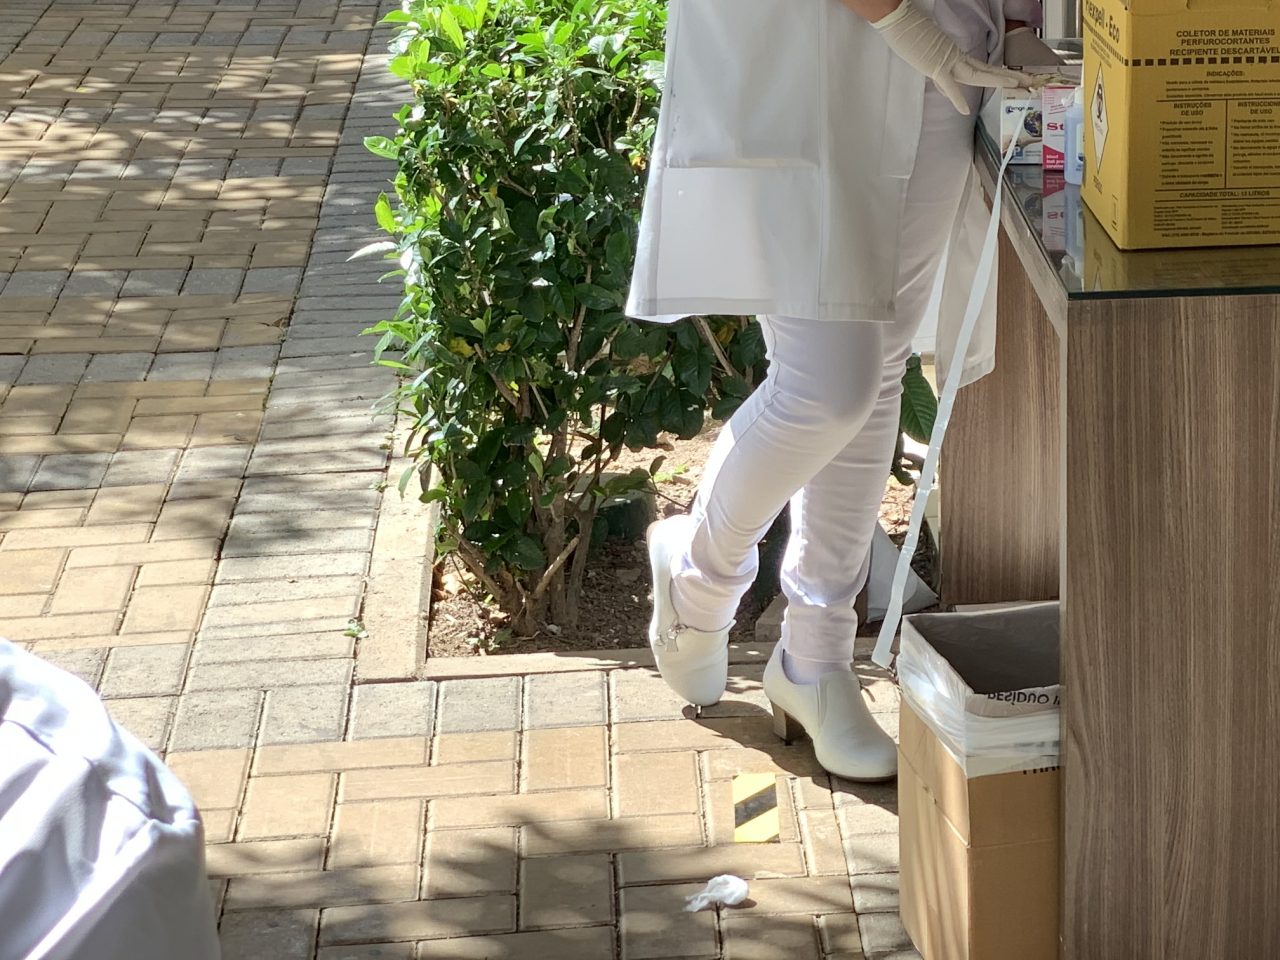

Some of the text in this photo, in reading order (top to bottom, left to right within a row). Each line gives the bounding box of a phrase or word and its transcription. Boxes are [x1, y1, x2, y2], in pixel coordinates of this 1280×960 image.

[1176, 28, 1276, 38] COLETOR DE MATERIAIS
[1181, 37, 1271, 46] PERFUROCORTANTES
[1169, 48, 1219, 56] RECIPIENTE
